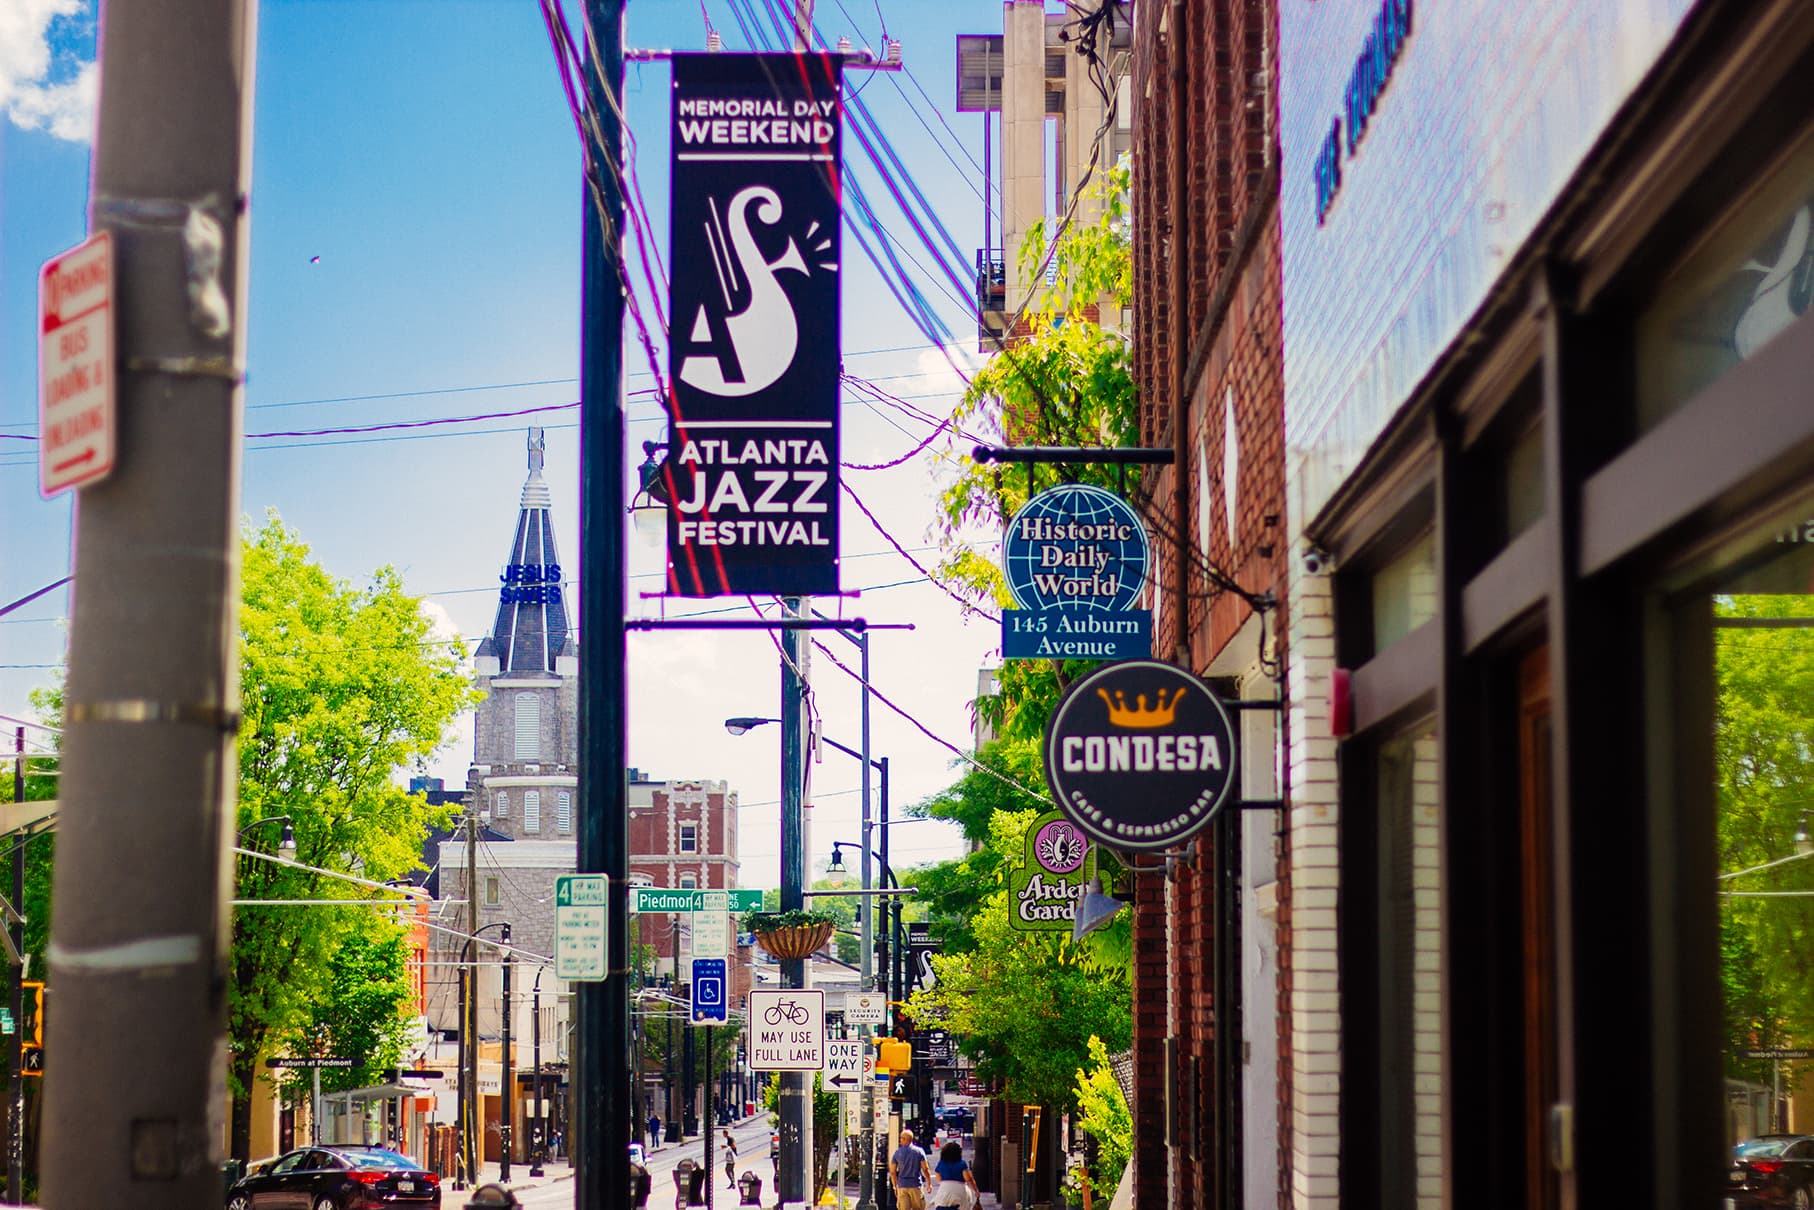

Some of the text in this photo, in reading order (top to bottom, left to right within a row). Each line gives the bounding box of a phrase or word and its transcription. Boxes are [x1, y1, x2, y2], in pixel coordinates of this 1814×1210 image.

[679, 100, 834, 117] MEMORIAL DAY
[678, 120, 834, 144] WEEKEND
[679, 440, 829, 465] ATLANTA
[678, 471, 828, 514] JAZZ
[679, 521, 829, 546] FESTIVAL
[1020, 517, 1131, 541] Historic
[1040, 545, 1110, 575] Daily
[499, 564, 561, 583] JESUS
[500, 585, 561, 604] SAVES
[1034, 574, 1118, 597] World
[1012, 614, 1140, 634] 145 Auburn
[1036, 635, 1117, 655] Avenue
[1062, 735, 1222, 772] CONDESA
[1102, 817, 1114, 830] &
[1116, 813, 1189, 837] ESPRESSO
[1189, 788, 1214, 816] BAR
[558, 881, 569, 903] 4
[639, 893, 692, 908] Piedmon
[693, 894, 702, 909] 4
[729, 892, 740, 901] NE
[1019, 898, 1077, 921] Gard
[761, 1031, 812, 1043] MAY USE
[755, 1049, 818, 1061] FULL LANE
[829, 1044, 858, 1057] ONE
[317, 1059, 352, 1067] Piedmont
[828, 1059, 857, 1070] WAY
